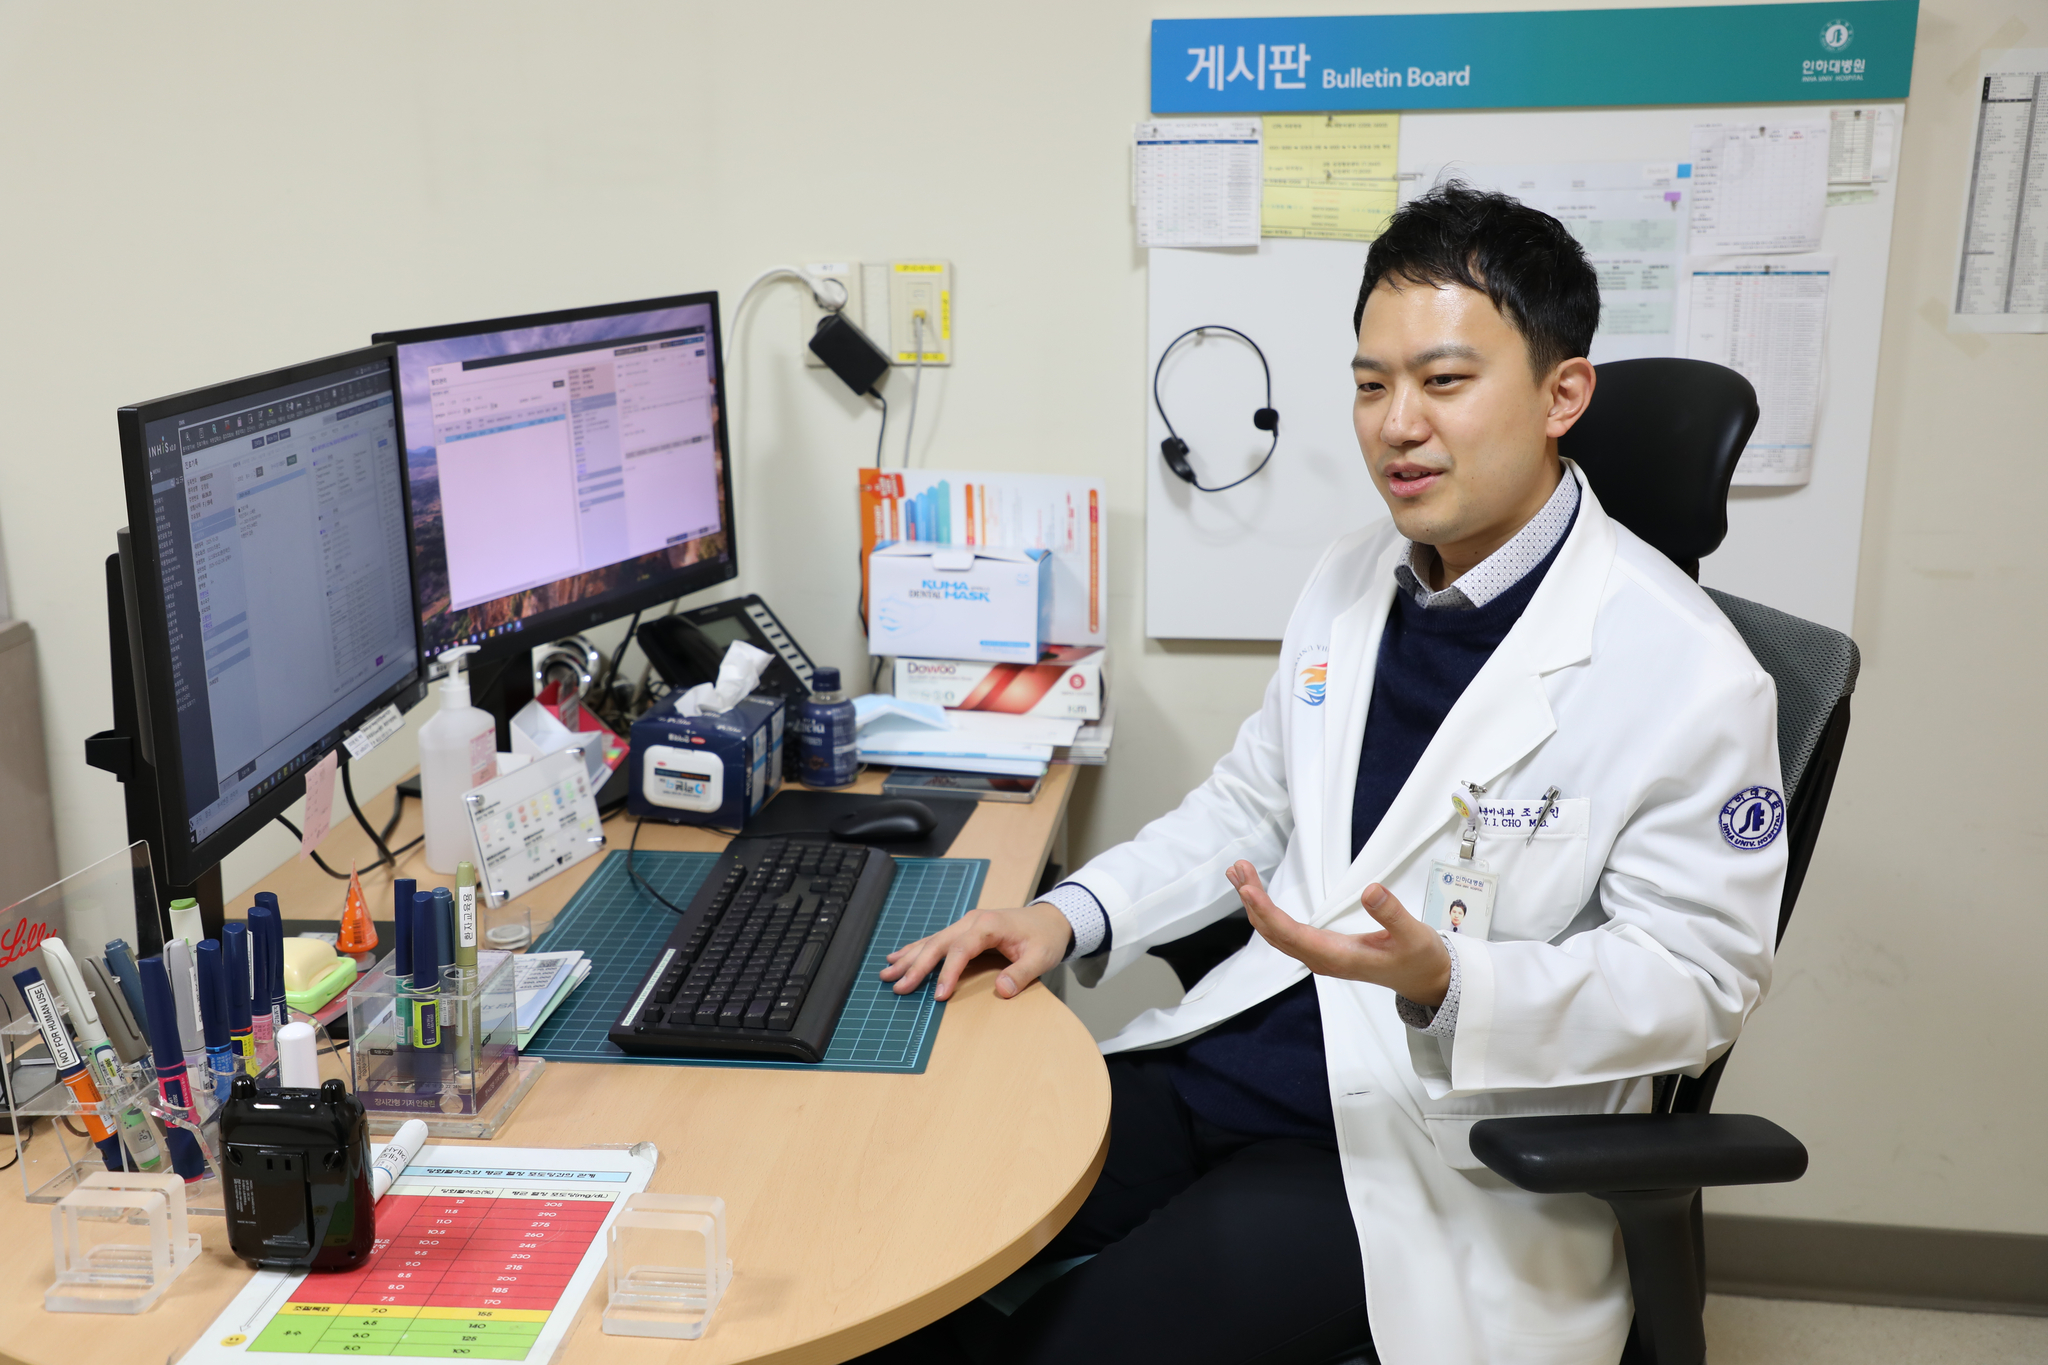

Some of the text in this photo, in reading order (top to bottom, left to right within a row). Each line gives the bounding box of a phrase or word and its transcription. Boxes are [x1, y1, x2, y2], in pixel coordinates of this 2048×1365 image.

[1185, 43, 1470, 91] 게시판 Bulletin Board
[1802, 58, 1866, 75] 인하대병원
[908, 590, 941, 599] DENTAL
[1502, 819, 1521, 827] CHO
[1723, 812, 1781, 847] INHA UNIV. HOSPITAL
[1456, 875, 1484, 887] 인하대병원
[463, 893, 473, 940] 환자교육용
[35, 988, 69, 1063] NOT FOR HUMAN USE
[375, 1098, 400, 1107] 장시간형
[416, 1100, 435, 1108] 인슐린
